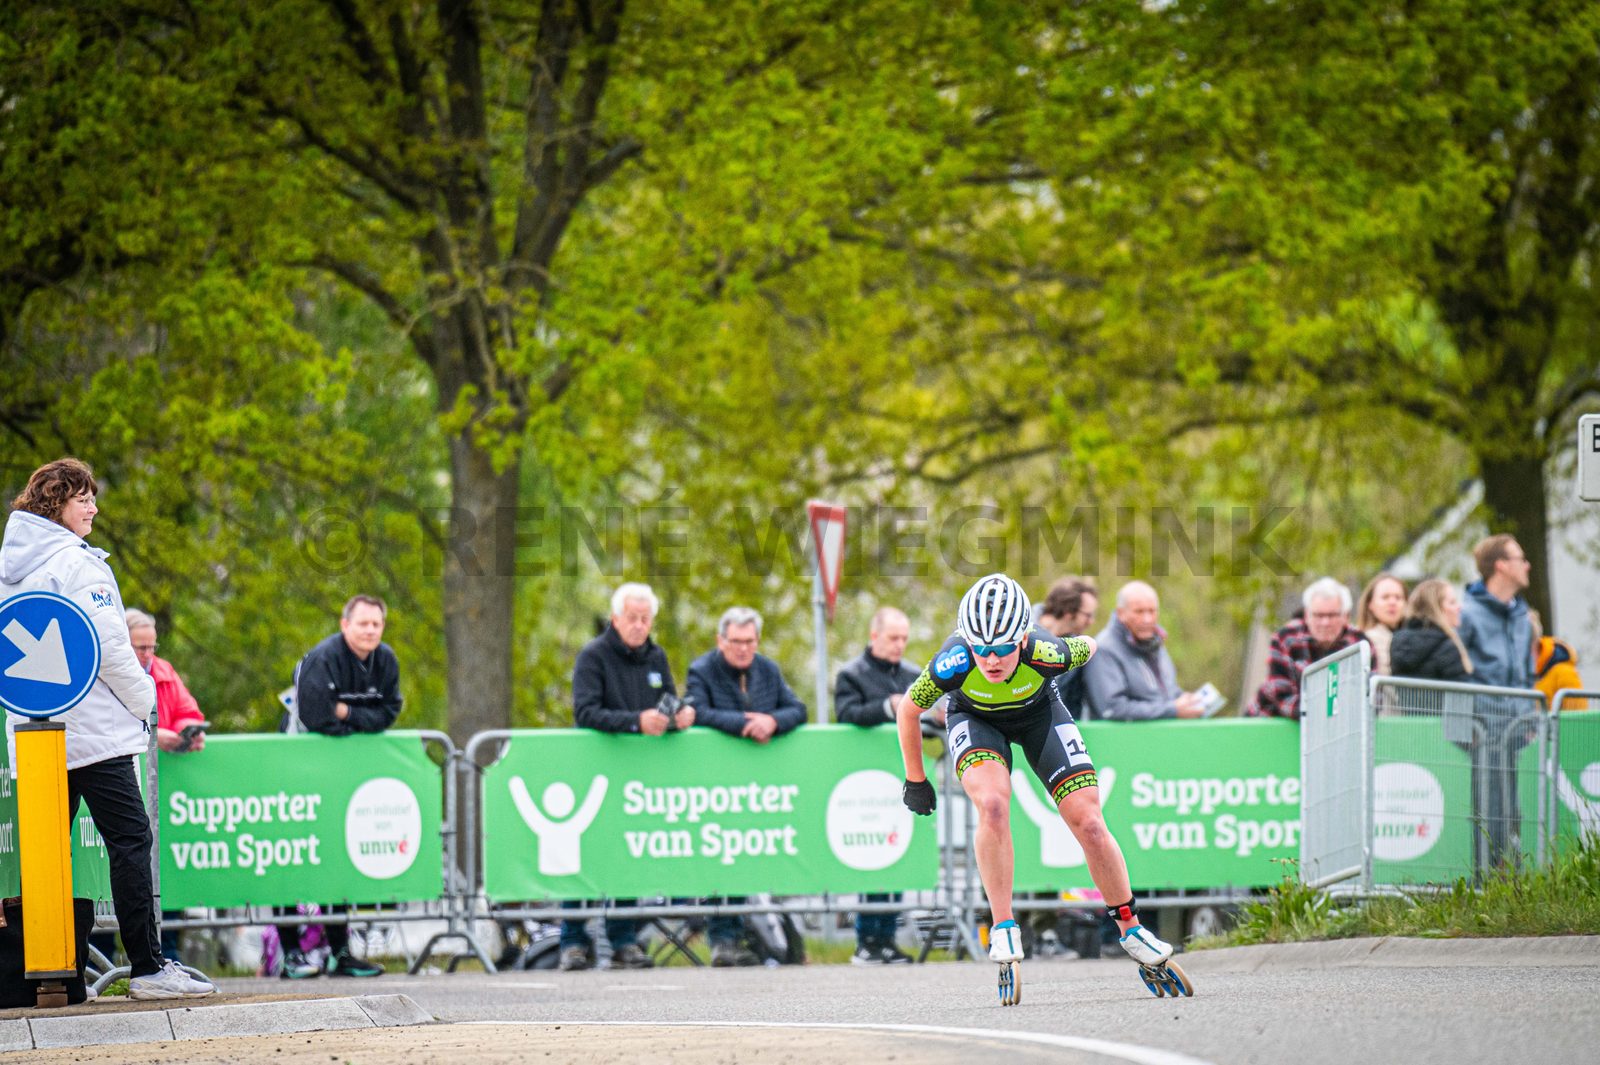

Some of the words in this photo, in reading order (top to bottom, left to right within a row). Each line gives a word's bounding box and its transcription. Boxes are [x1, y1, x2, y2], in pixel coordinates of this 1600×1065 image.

[936, 652, 967, 673] KMC
[1066, 738, 1088, 757] 1
[170, 791, 321, 832] Supporter
[624, 781, 799, 823] Supporter
[1131, 772, 1300, 815] Supporte
[171, 841, 229, 870] van
[237, 834, 321, 877] Sport
[625, 831, 693, 858] van
[701, 824, 798, 866] Sport
[1132, 821, 1207, 851] van
[1214, 813, 1300, 858] Spor
